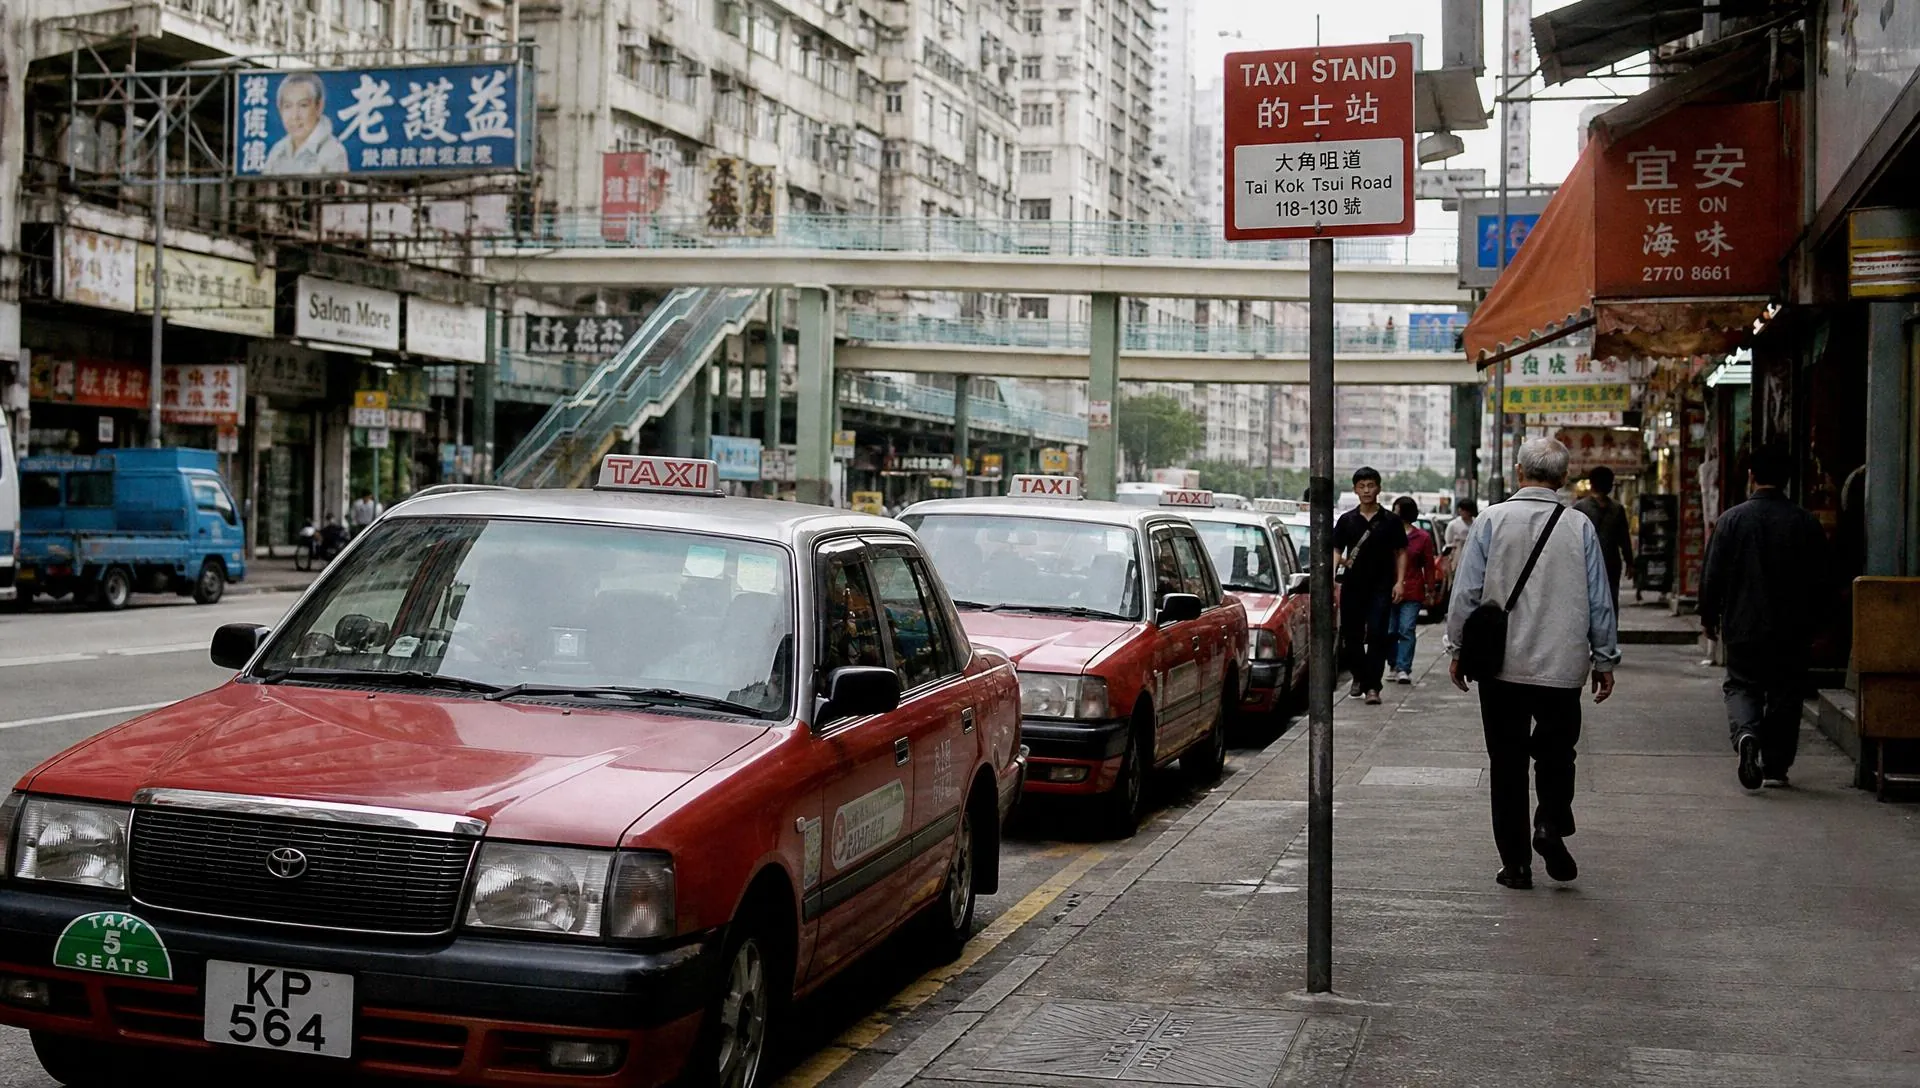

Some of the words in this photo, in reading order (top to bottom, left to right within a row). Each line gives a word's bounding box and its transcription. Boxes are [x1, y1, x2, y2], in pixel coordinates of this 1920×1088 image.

[1240, 62, 1296, 87] TAXI
[1312, 56, 1397, 83] STAND
[337, 69, 515, 144] 老護益
[1257, 92, 1379, 128] 的士站
[1275, 149, 1361, 172] 大角咀道
[1626, 143, 1746, 190] 宜安
[1245, 180, 1267, 195] Tai
[1275, 178, 1304, 193] Kok
[1312, 177, 1344, 192] Tsui
[1351, 175, 1392, 190] Road
[1276, 200, 1338, 217] 118-130
[1343, 197, 1362, 216] 號
[1644, 198, 1682, 215] YEE
[1699, 196, 1728, 213] ON
[1642, 221, 1734, 258] 海味
[1642, 266, 1684, 281] 2770
[1691, 265, 1731, 280] 8661
[309, 292, 351, 324] Salon
[356, 301, 391, 329] More
[607, 459, 708, 489] TAXI
[1018, 478, 1072, 494] TAXI
[1166, 491, 1211, 505] TAXI
[87, 914, 141, 935] TAXI
[102, 929, 122, 955] 5
[75, 952, 149, 974] SEATS
[246, 967, 312, 1008] KP
[228, 1003, 326, 1052] 564
